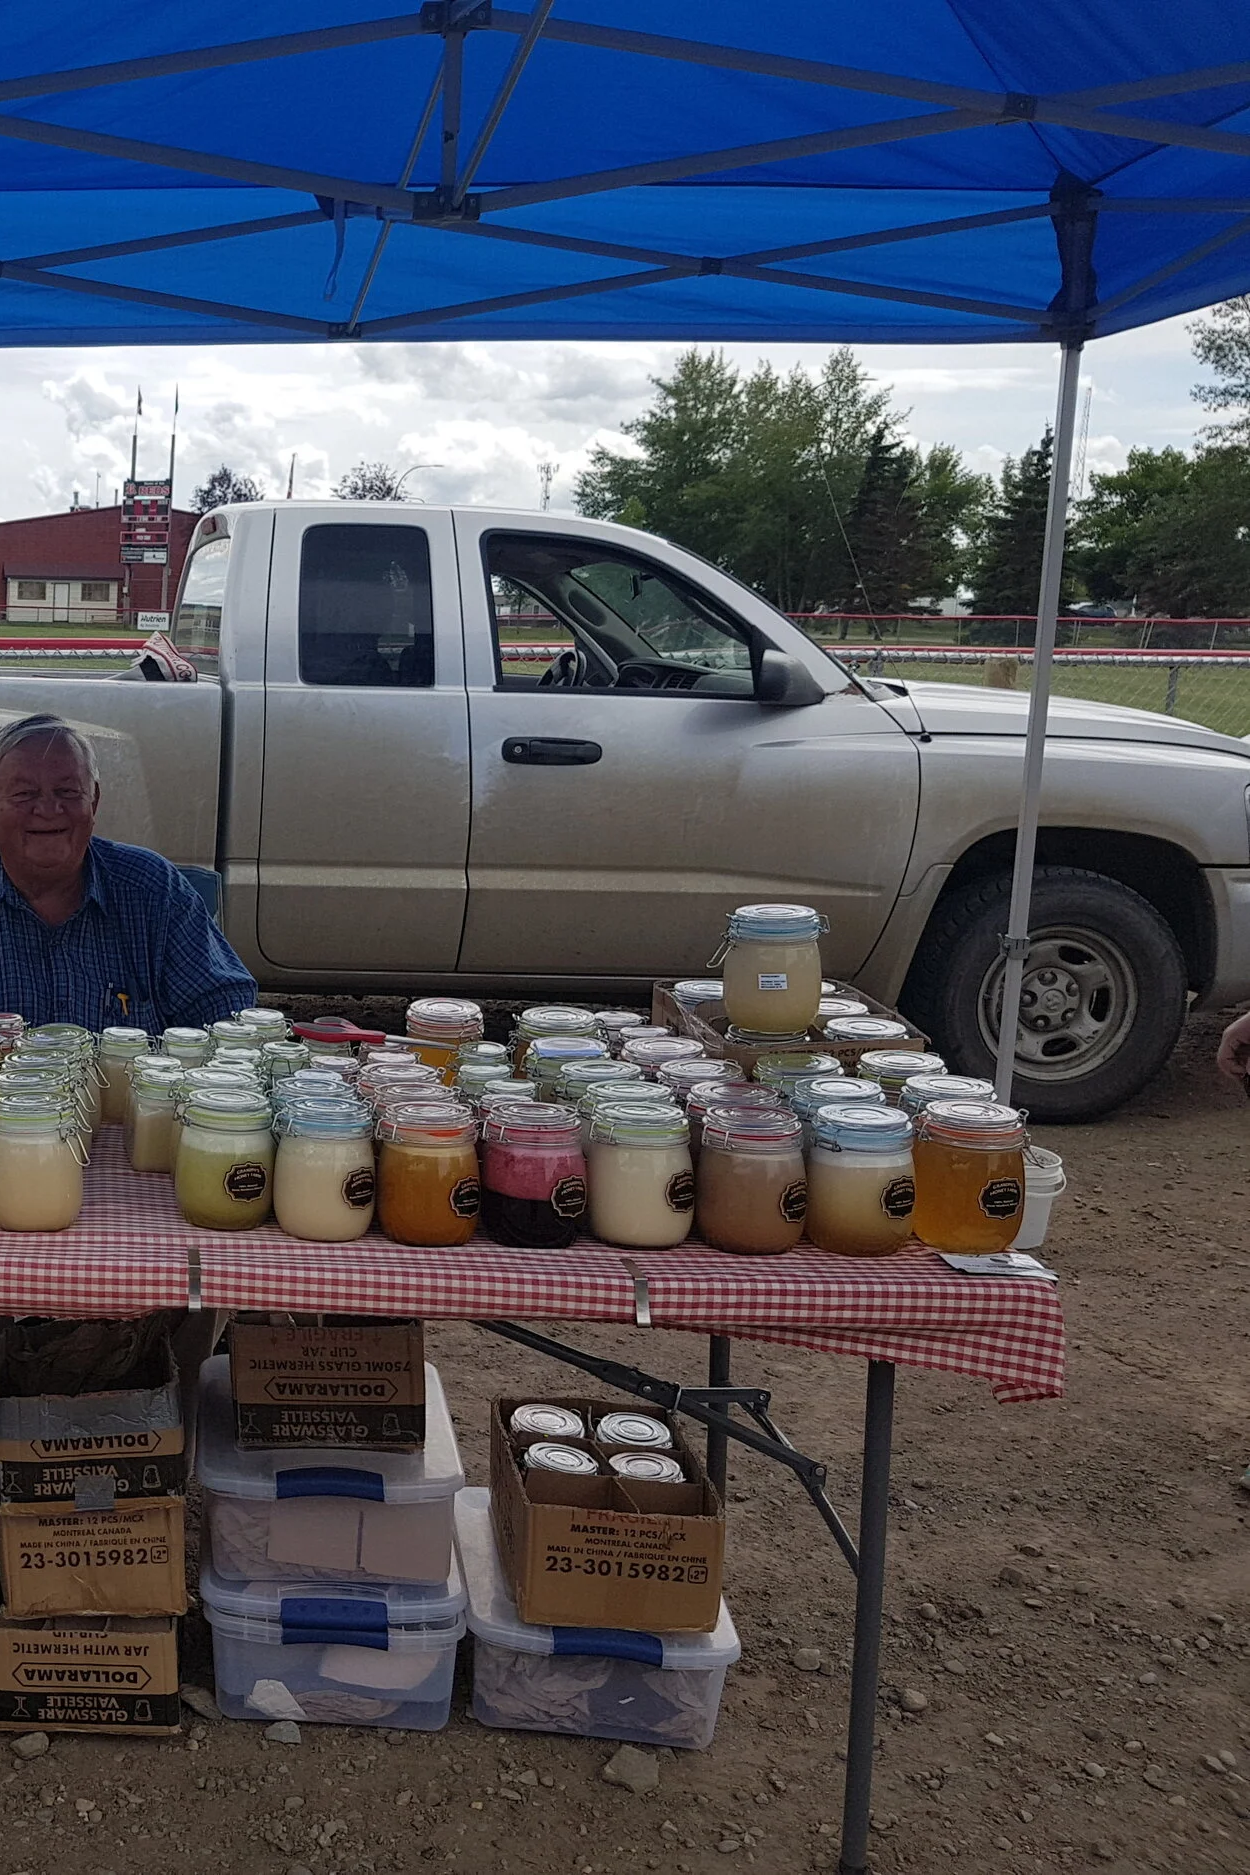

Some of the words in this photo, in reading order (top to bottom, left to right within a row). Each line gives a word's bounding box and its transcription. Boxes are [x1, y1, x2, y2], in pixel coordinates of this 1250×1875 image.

[139, 486, 170, 496] REDS
[141, 614, 166, 623] Nutrien
[301, 1346, 326, 1357] JAR
[330, 1347, 358, 1358] CLIP
[249, 1359, 315, 1371] HERMETIC
[318, 1360, 362, 1372] GLASS
[364, 1361, 411, 1372] 750ML
[274, 1382, 386, 1397] DOLLARAMA
[281, 1410, 358, 1424] VAISSELLE
[272, 1423, 369, 1437] GLASSWARE
[41, 1433, 149, 1452] DOLLARAMA
[42, 1464, 118, 1482] VAISSELLE
[33, 1478, 130, 1496] GWARE
[38, 1517, 83, 1528] MASTER:
[86, 1516, 99, 1525] 12
[101, 1514, 145, 1524] PCS/MCX
[53, 1528, 96, 1538] MONTREAL
[97, 1527, 132, 1536] CANADA
[570, 1524, 620, 1536] MASTER:
[624, 1528, 637, 1537] 12
[639, 1530, 687, 1542] PCS/CX
[20, 1541, 42, 1549] MADE
[44, 1541, 53, 1549] IN
[55, 1540, 81, 1548] CHINA
[89, 1538, 128, 1547] FABRIQUE
[130, 1537, 141, 1545] EN
[143, 1536, 166, 1544] CHINE
[584, 1537, 633, 1548] MONTREAL
[20, 1549, 149, 1569] 23-3015982
[547, 1544, 571, 1553] MADE
[574, 1546, 584, 1554] IN
[586, 1547, 614, 1557] CHINA
[623, 1550, 665, 1561] FABRIQUE
[667, 1554, 680, 1563] EN
[681, 1556, 707, 1564] CHINE
[545, 1555, 685, 1583] 23-3015982
[13, 1642, 80, 1654] HERMETIC
[84, 1643, 120, 1656] WITH
[125, 1644, 150, 1657] JAR
[24, 1669, 138, 1684] DOLLARAMA
[47, 1696, 119, 1709] VAISSELLE
[38, 1708, 128, 1722] GLASSWARE
